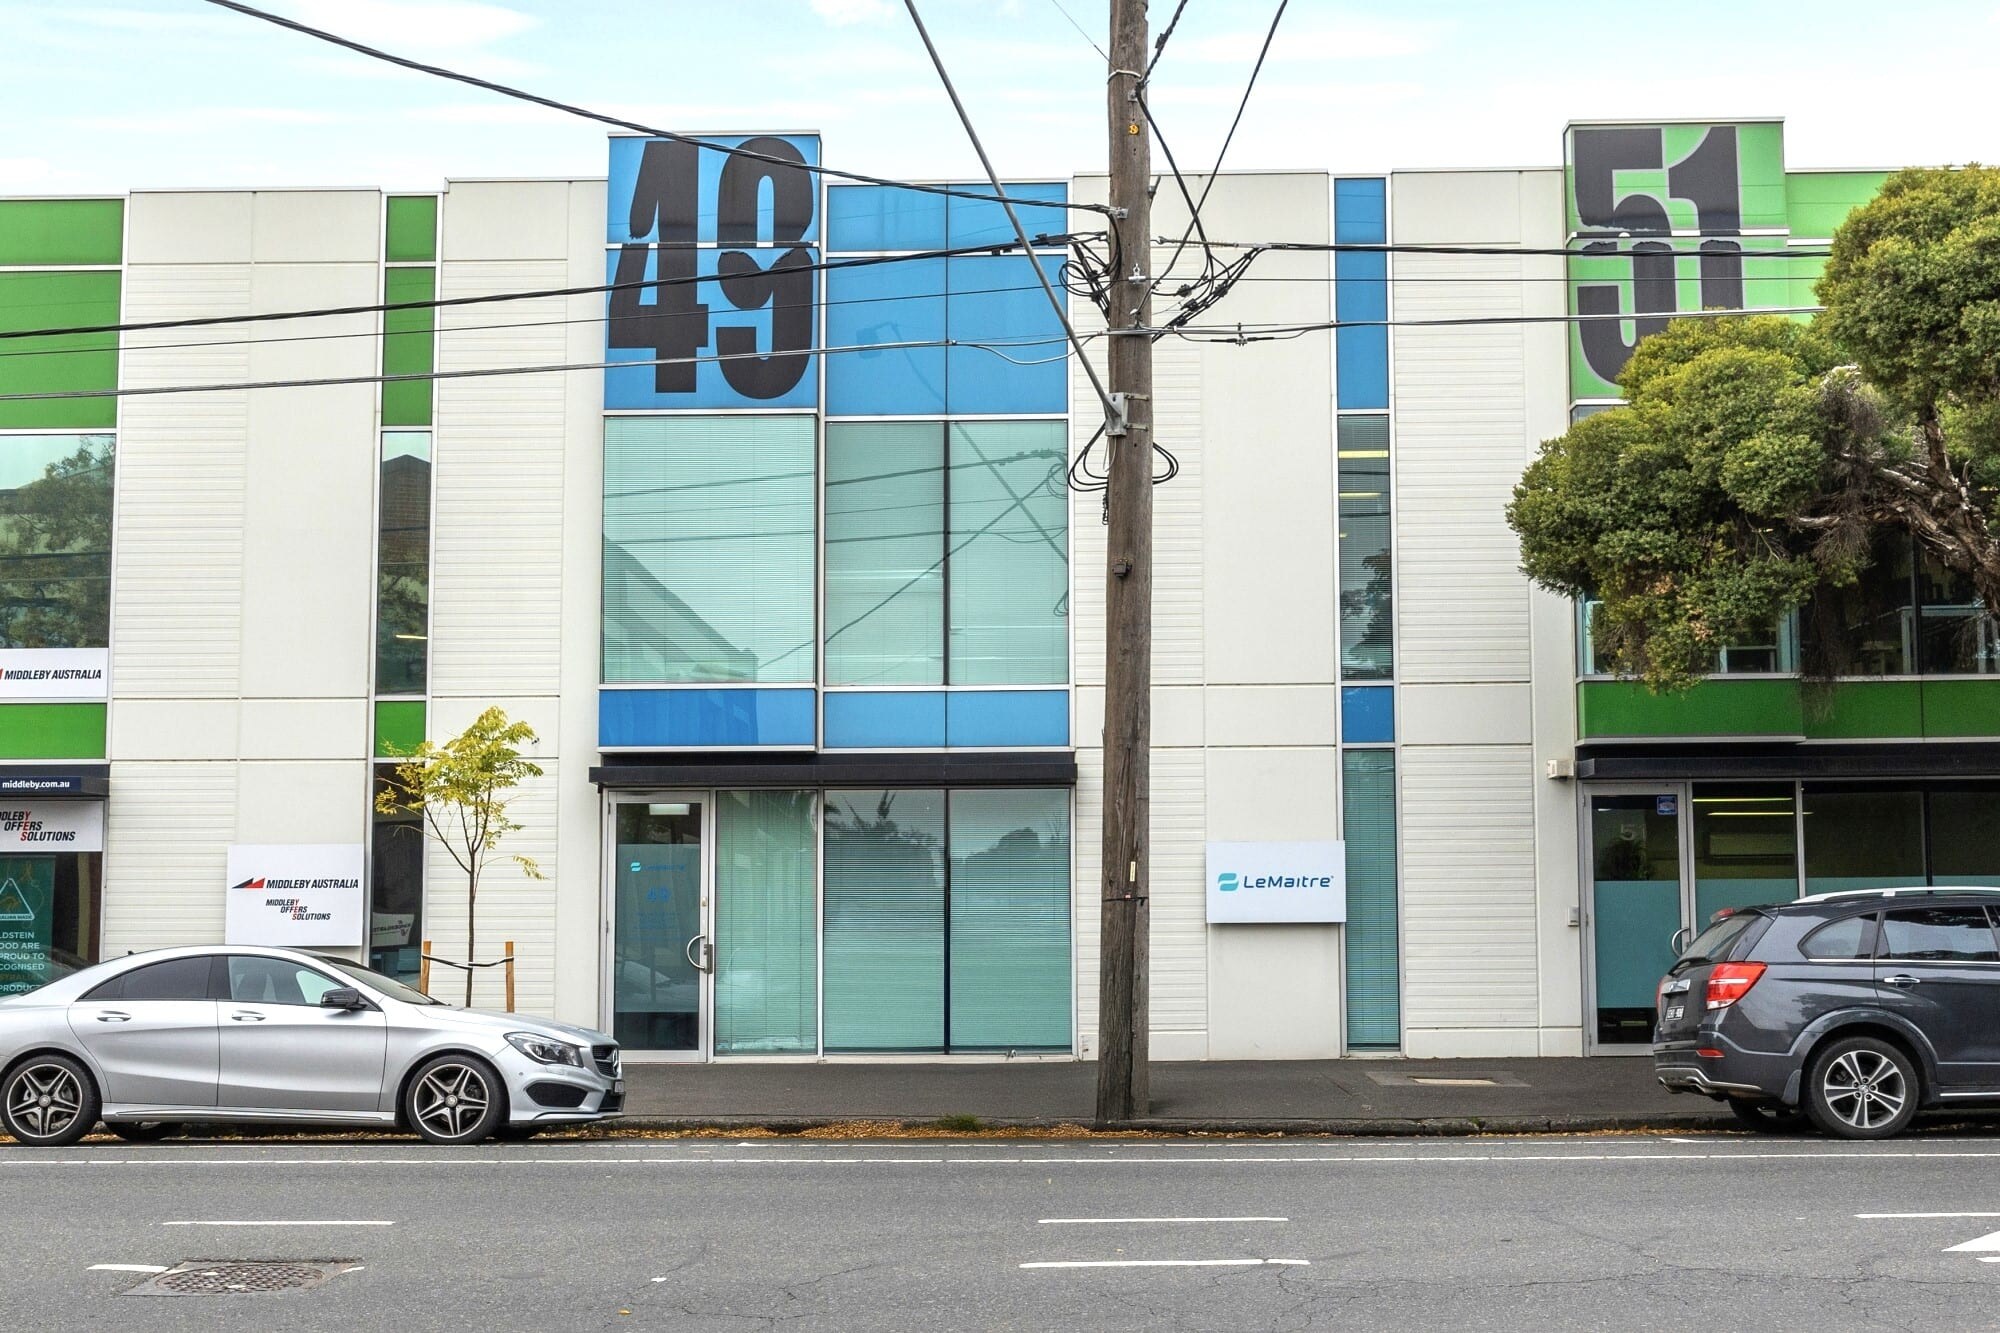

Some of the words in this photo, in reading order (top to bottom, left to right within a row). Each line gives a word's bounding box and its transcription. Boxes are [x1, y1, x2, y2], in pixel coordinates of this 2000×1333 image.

[1574, 126, 1744, 386] 51
[608, 137, 814, 399] 49
[4, 669, 51, 680] MIDDLEBY
[51, 669, 102, 680] AUSTRALIA
[2, 780, 70, 790] middleby.com.au
[4, 821, 43, 831] OFFERS
[20, 831, 76, 841] SOLUTIONS
[266, 879, 311, 889] MIDDLEBY
[311, 879, 359, 889] AUSTRALIA
[21, 942, 41, 950] ARE
[31, 952, 45, 960] TO
